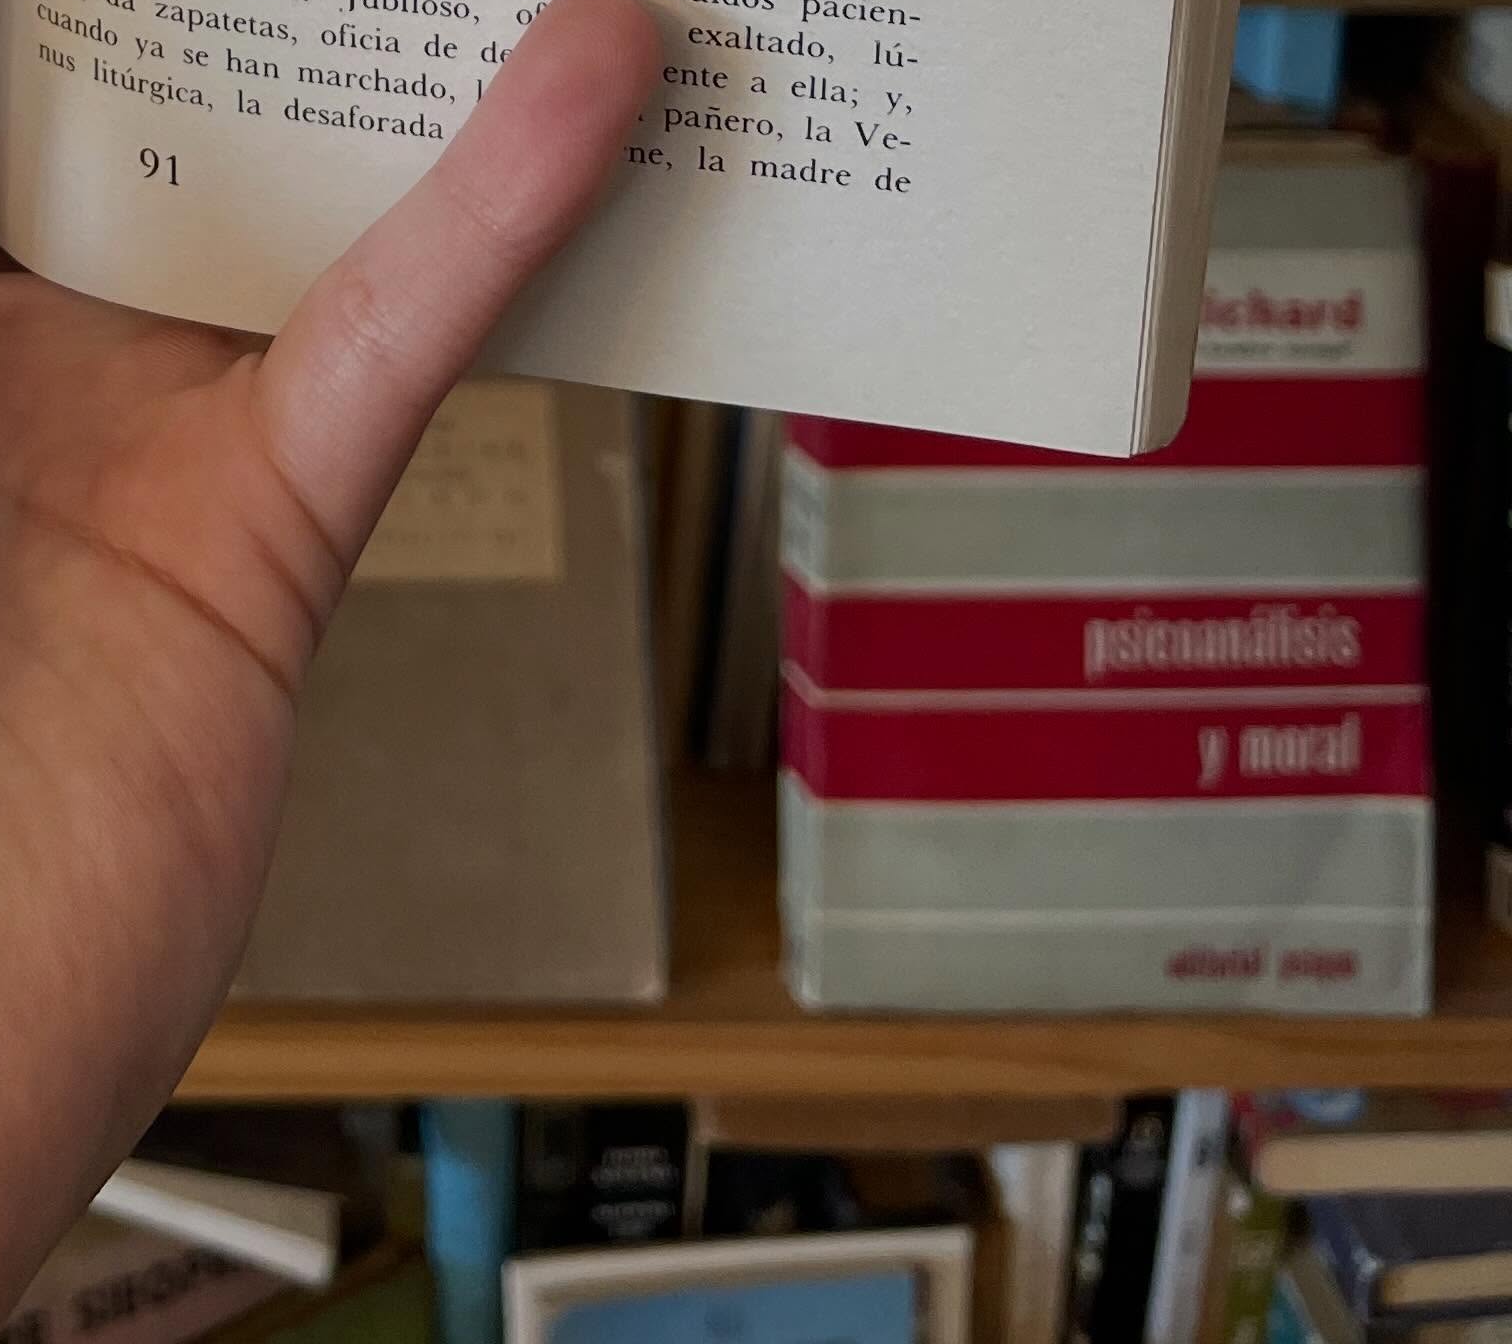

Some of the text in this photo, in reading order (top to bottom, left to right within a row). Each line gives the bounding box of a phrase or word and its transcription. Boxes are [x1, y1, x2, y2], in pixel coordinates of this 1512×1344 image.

[39, 43, 444, 140] nus litúrgica, la desaforada
[139, 147, 180, 187] 91
[1240, 713, 1361, 775] moral
